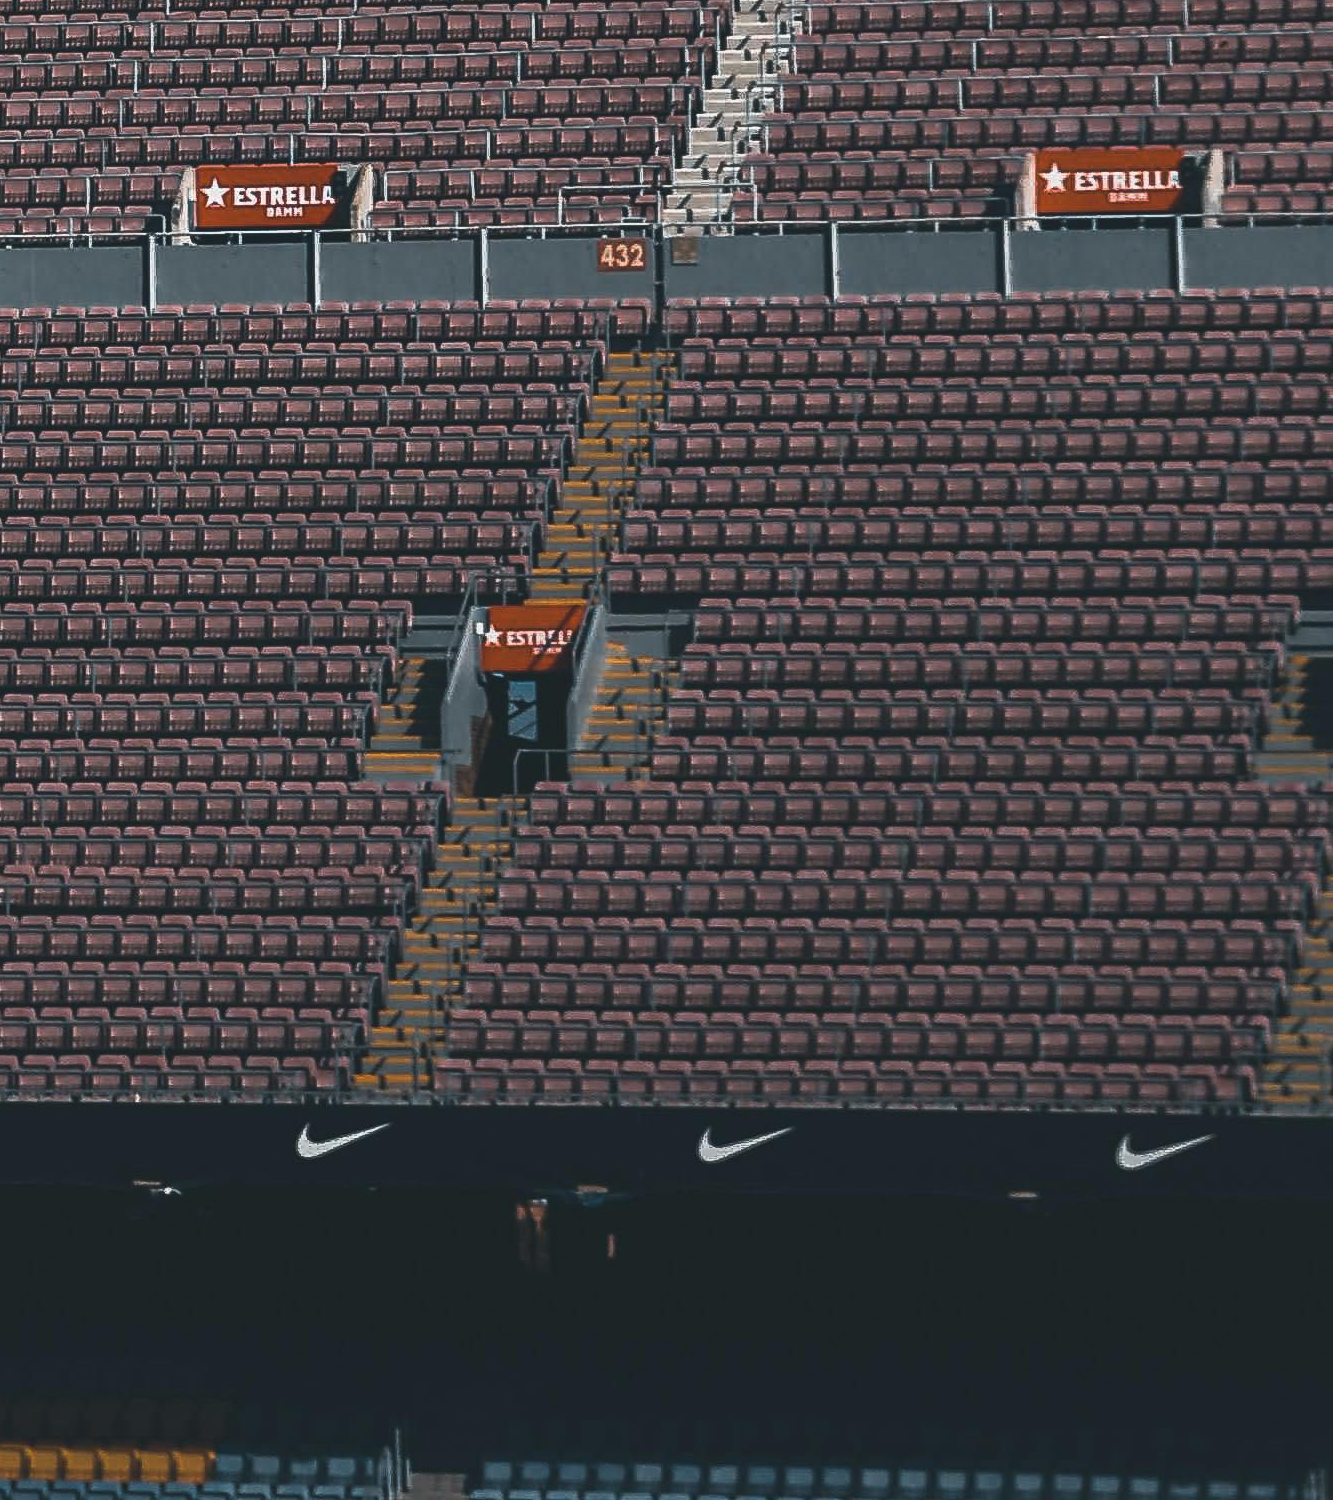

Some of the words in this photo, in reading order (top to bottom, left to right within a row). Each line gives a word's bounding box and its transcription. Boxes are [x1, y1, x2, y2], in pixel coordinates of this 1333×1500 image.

[1073, 170, 1183, 192] ESTRELLA
[232, 185, 337, 206] ESTRELLA
[265, 206, 304, 218] DAMM
[600, 243, 645, 268] 432
